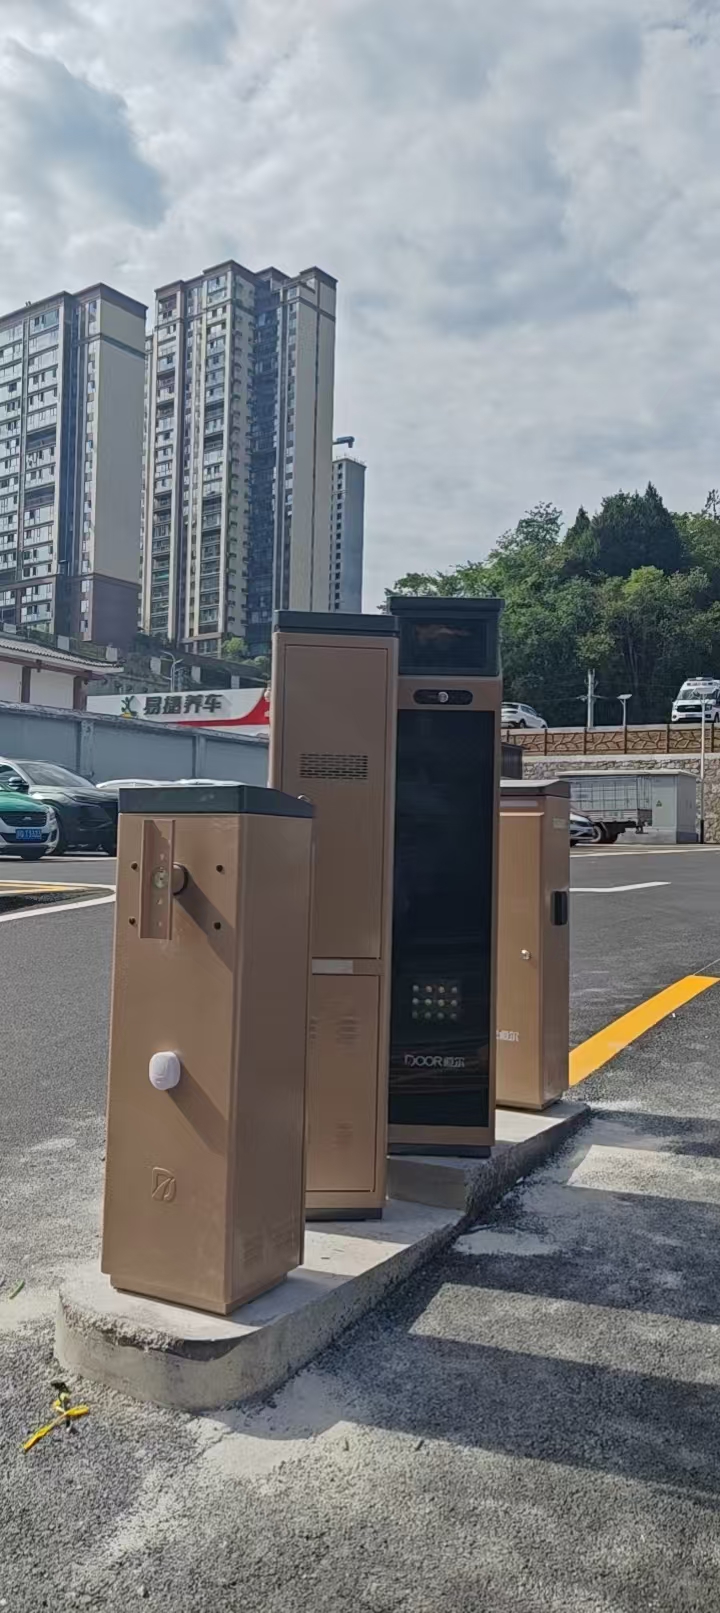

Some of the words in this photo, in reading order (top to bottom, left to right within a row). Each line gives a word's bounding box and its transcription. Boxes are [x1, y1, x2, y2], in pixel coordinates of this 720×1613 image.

[143, 693, 224, 715] 易捷养车
[404, 1054, 442, 1067] DOOR
